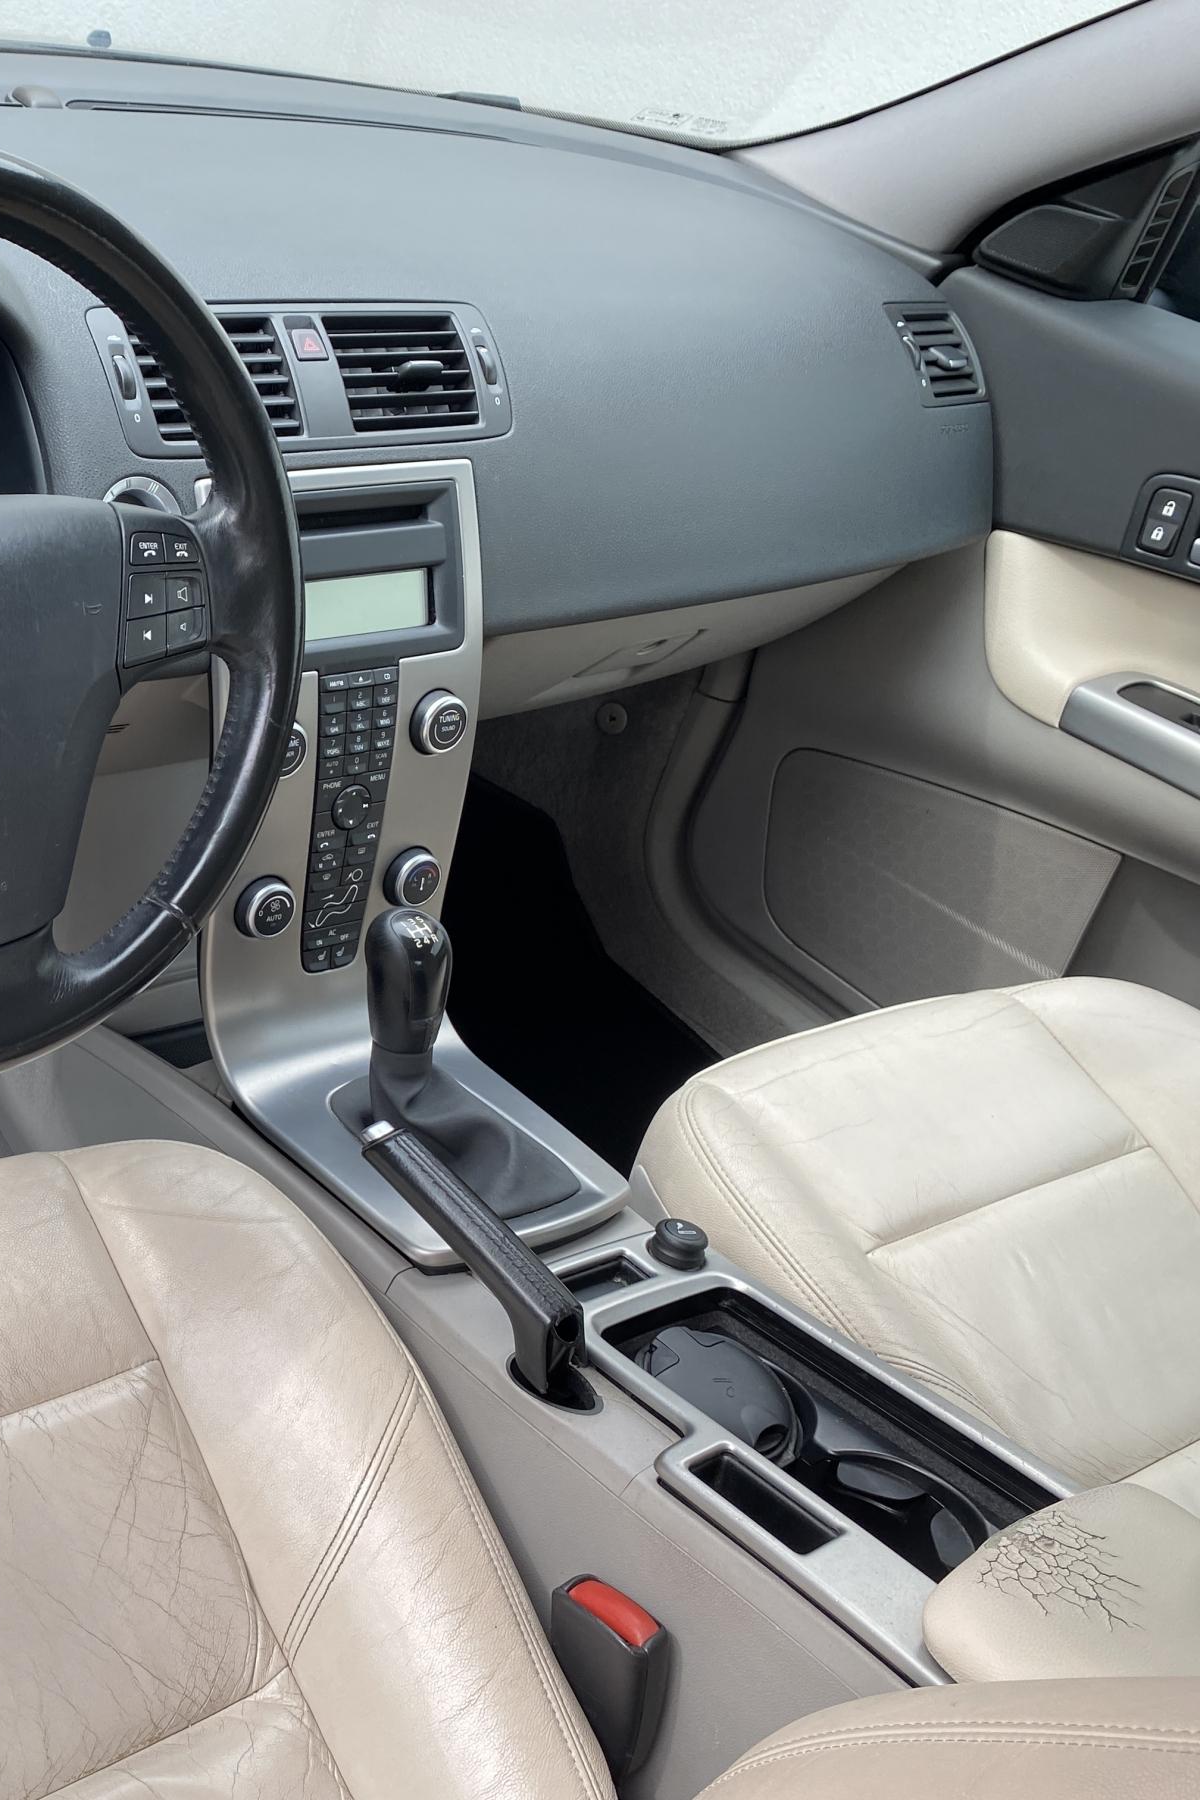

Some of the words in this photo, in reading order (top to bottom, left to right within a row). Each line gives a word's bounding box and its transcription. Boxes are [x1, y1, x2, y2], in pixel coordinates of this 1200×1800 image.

[139, 542, 158, 550] ENTER
[439, 713, 460, 723] TUNING
[370, 773, 386, 782] MENU
[323, 781, 342, 790] PHONE
[367, 821, 379, 829] EXIT
[317, 829, 335, 838] ENTER
[266, 913, 282, 922] AUTO
[407, 918, 417, 926] 3
[430, 934, 439, 943] R
[414, 939, 423, 948] 2
